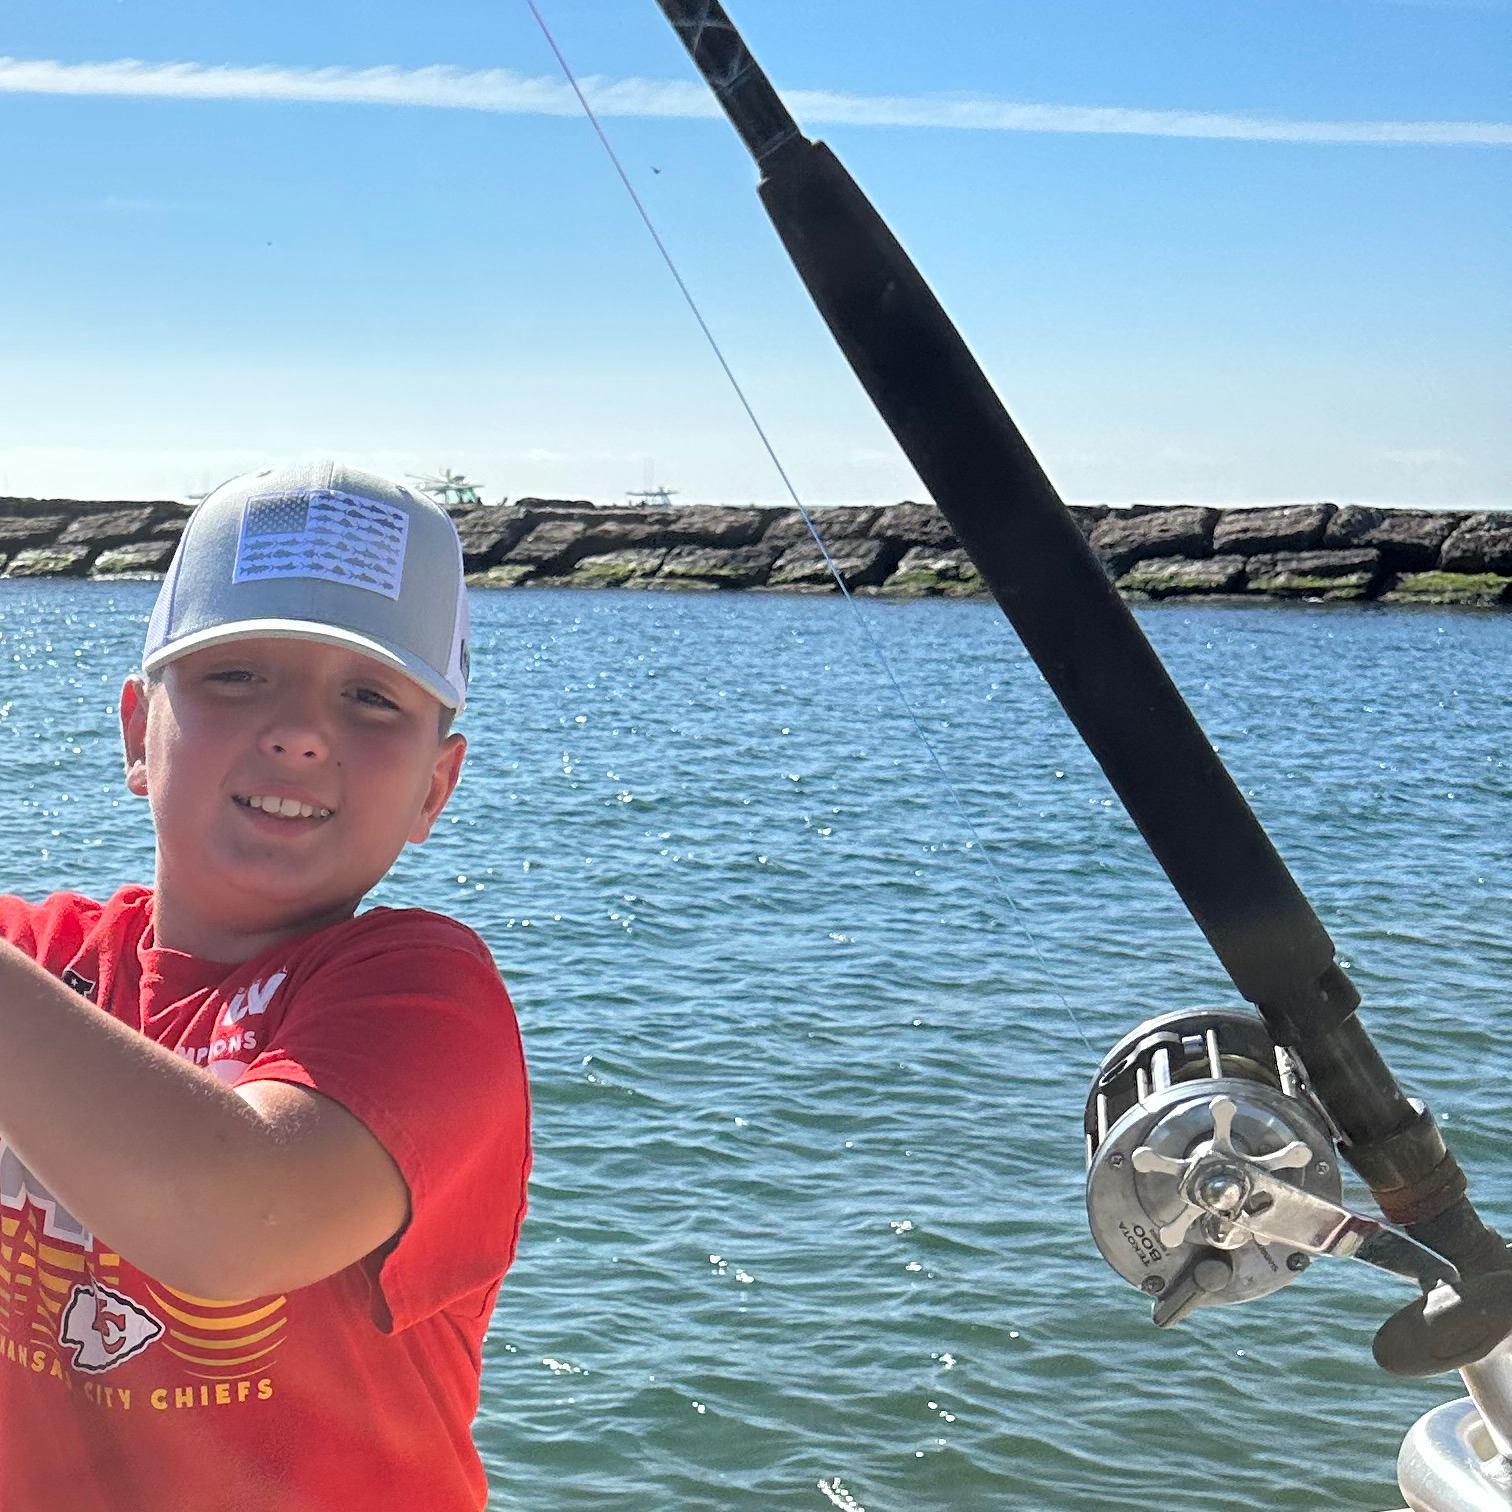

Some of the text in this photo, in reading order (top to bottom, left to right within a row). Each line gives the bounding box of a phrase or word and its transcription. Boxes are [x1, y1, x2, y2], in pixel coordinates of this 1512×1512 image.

[178, 1031, 257, 1064] MPIONS
[1119, 1221, 1150, 1267] TEKOTA
[1133, 1225, 1163, 1262] 800
[84, 1381, 131, 1410] CITY
[150, 1378, 274, 1411] CHIEFS
